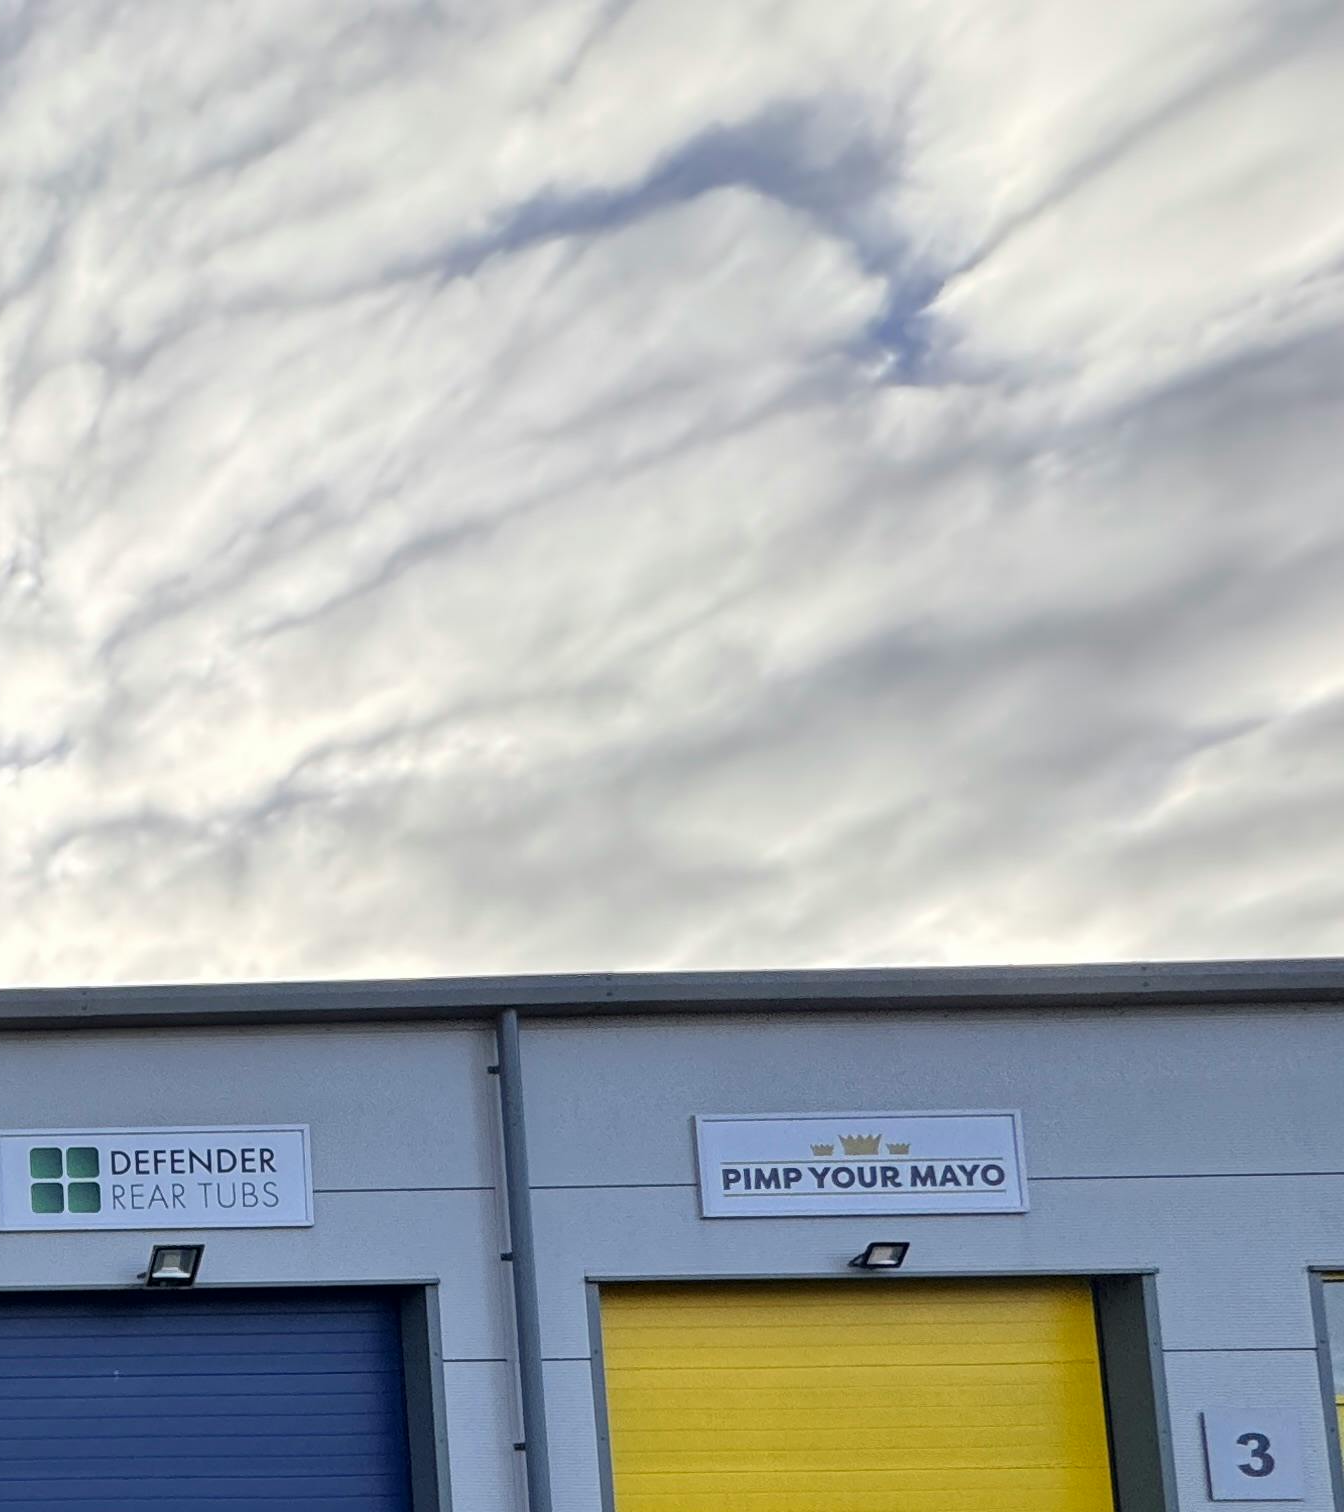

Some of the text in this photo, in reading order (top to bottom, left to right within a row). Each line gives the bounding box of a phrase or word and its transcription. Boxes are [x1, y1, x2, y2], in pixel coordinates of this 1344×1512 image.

[111, 1147, 277, 1176] DEFENDER
[722, 1164, 1005, 1191] PIMP YOUR MAYO
[111, 1181, 279, 1210] REAR TUBS
[1236, 1432, 1275, 1478] 3
